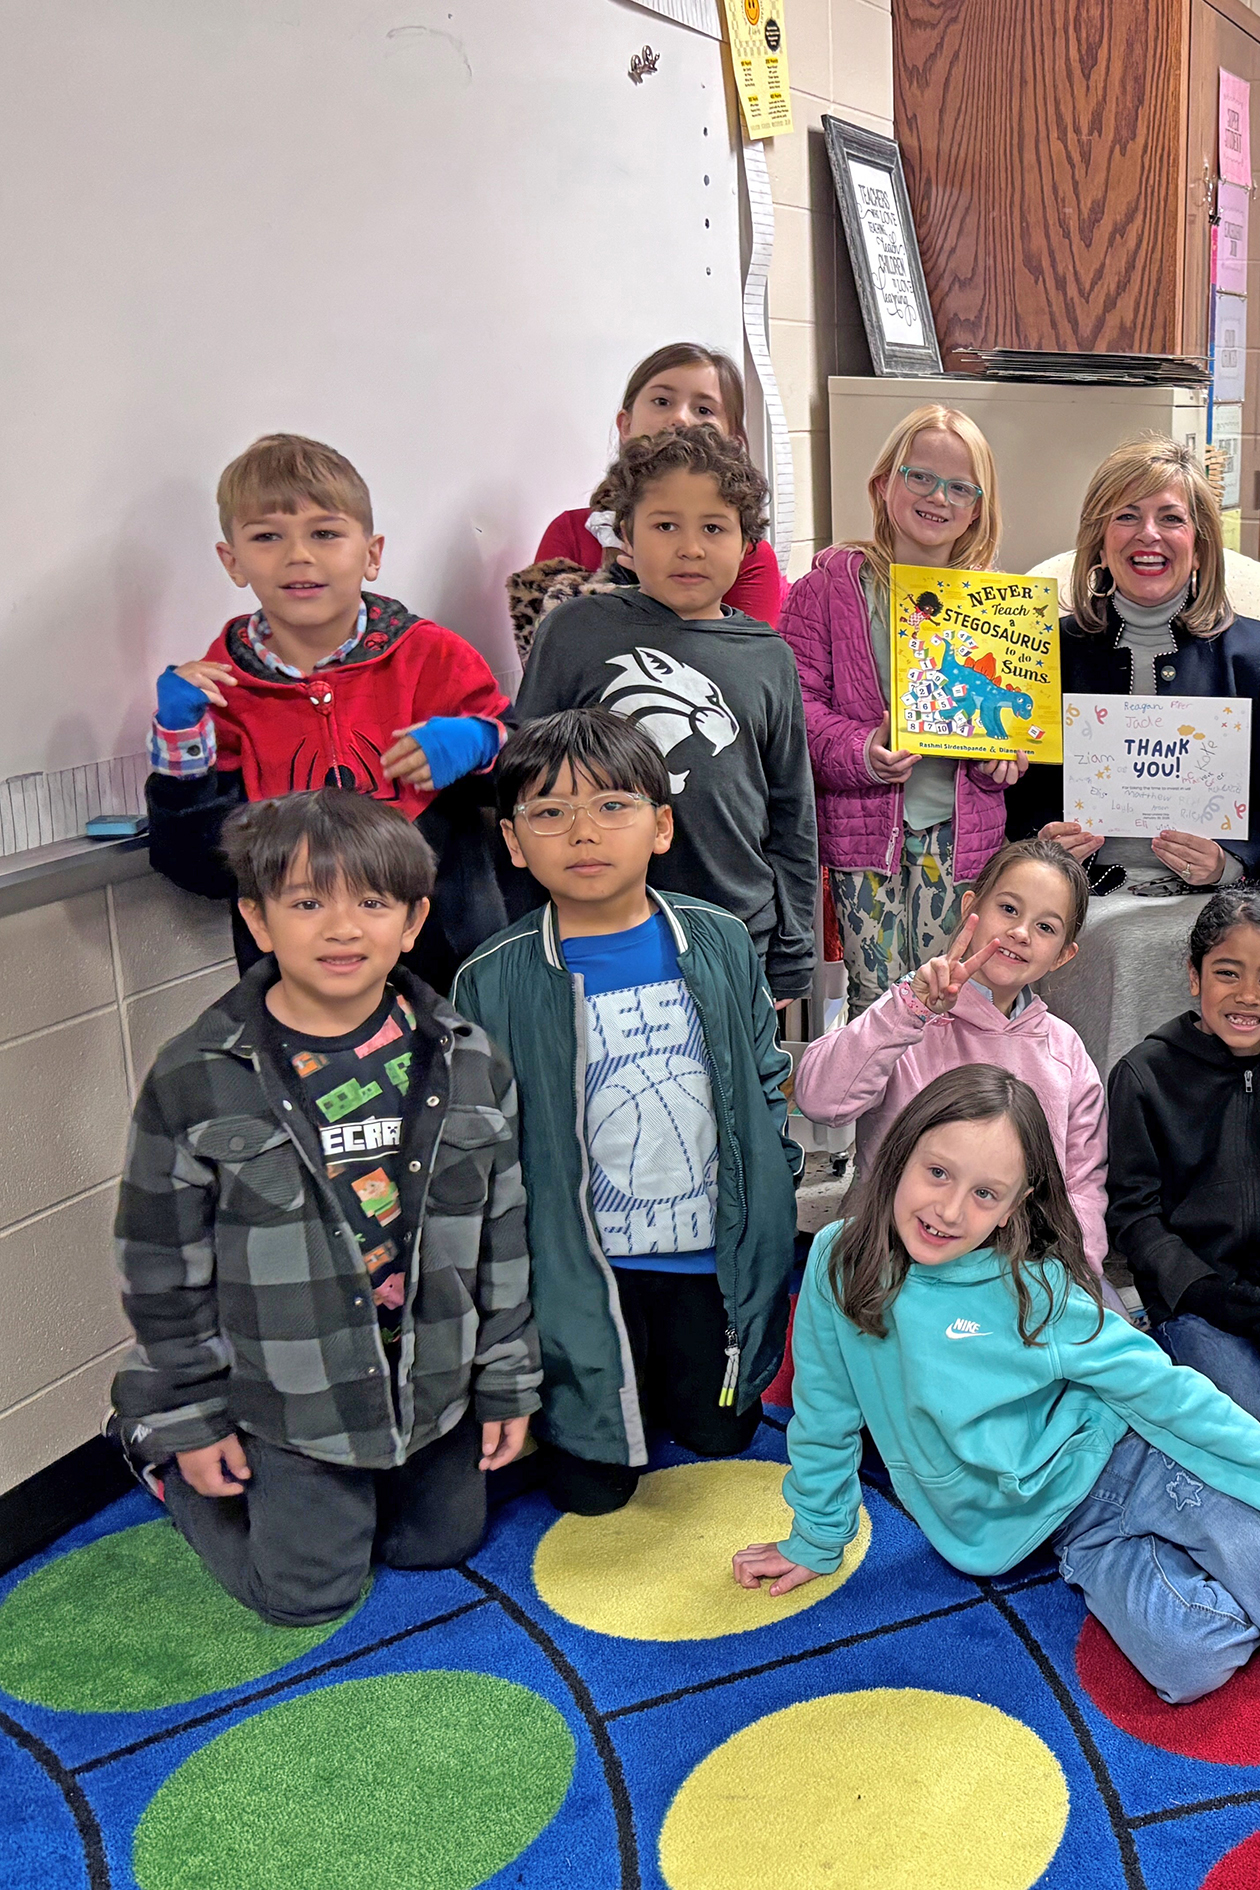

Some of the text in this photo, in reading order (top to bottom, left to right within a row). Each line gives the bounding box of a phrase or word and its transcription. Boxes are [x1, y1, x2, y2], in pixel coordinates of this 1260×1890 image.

[879, 210, 897, 227] LOVE
[967, 585, 1033, 607] NEVER
[992, 603, 1030, 616] Teach
[1009, 619, 1015, 627] a
[943, 608, 1051, 655] STEGOSAURUS
[1005, 647, 1031, 663] to do
[1002, 660, 1051, 684] Sums
[1124, 701, 1163, 713] Reagan
[1125, 716, 1164, 729] Jade
[1124, 738, 1190, 758] THANK
[1133, 756, 1180, 778] YOU!
[953, 1318, 980, 1333] NIKE
